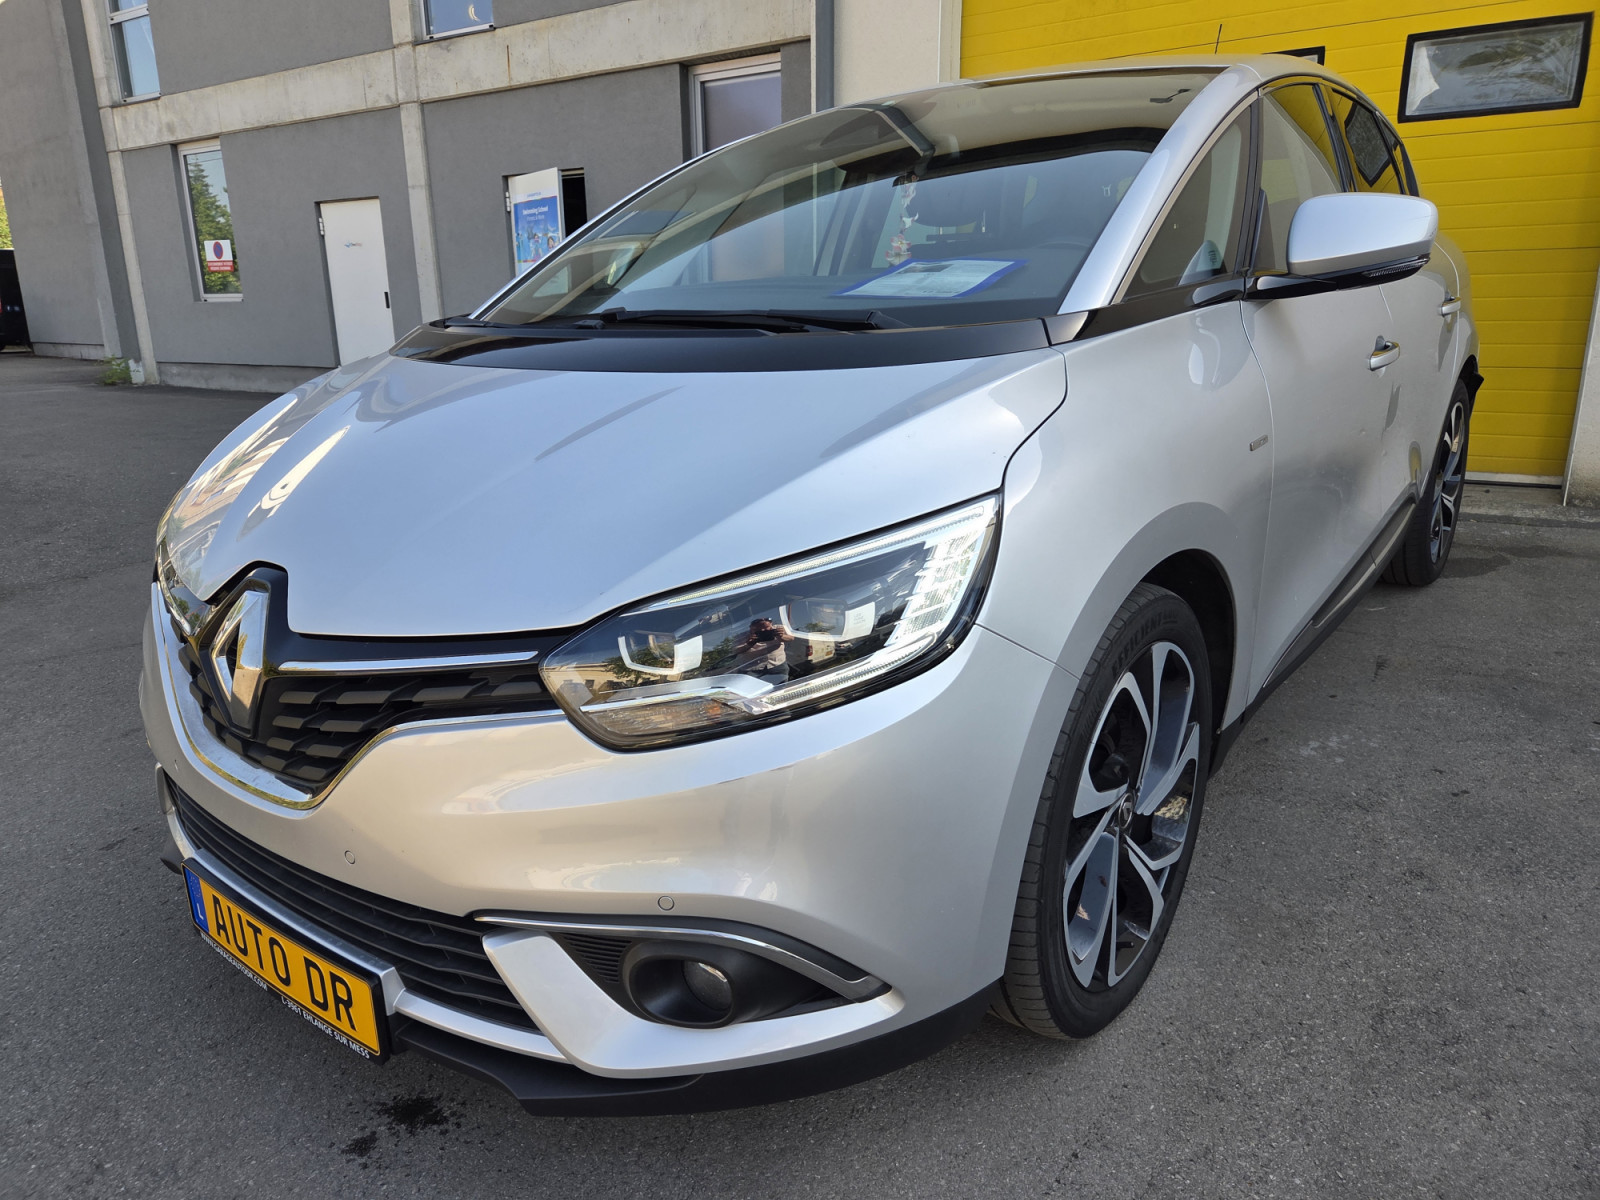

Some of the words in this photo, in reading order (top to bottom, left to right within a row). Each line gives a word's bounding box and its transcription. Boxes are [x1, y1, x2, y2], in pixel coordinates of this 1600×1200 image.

[197, 902, 204, 921] L
[212, 893, 291, 987] AUTO
[303, 956, 357, 1032] DR
[281, 996, 302, 1016] L-3961
[302, 1011, 333, 1037] EHLANGE
[333, 1031, 349, 1047] SUR
[349, 1041, 370, 1059] MESS
